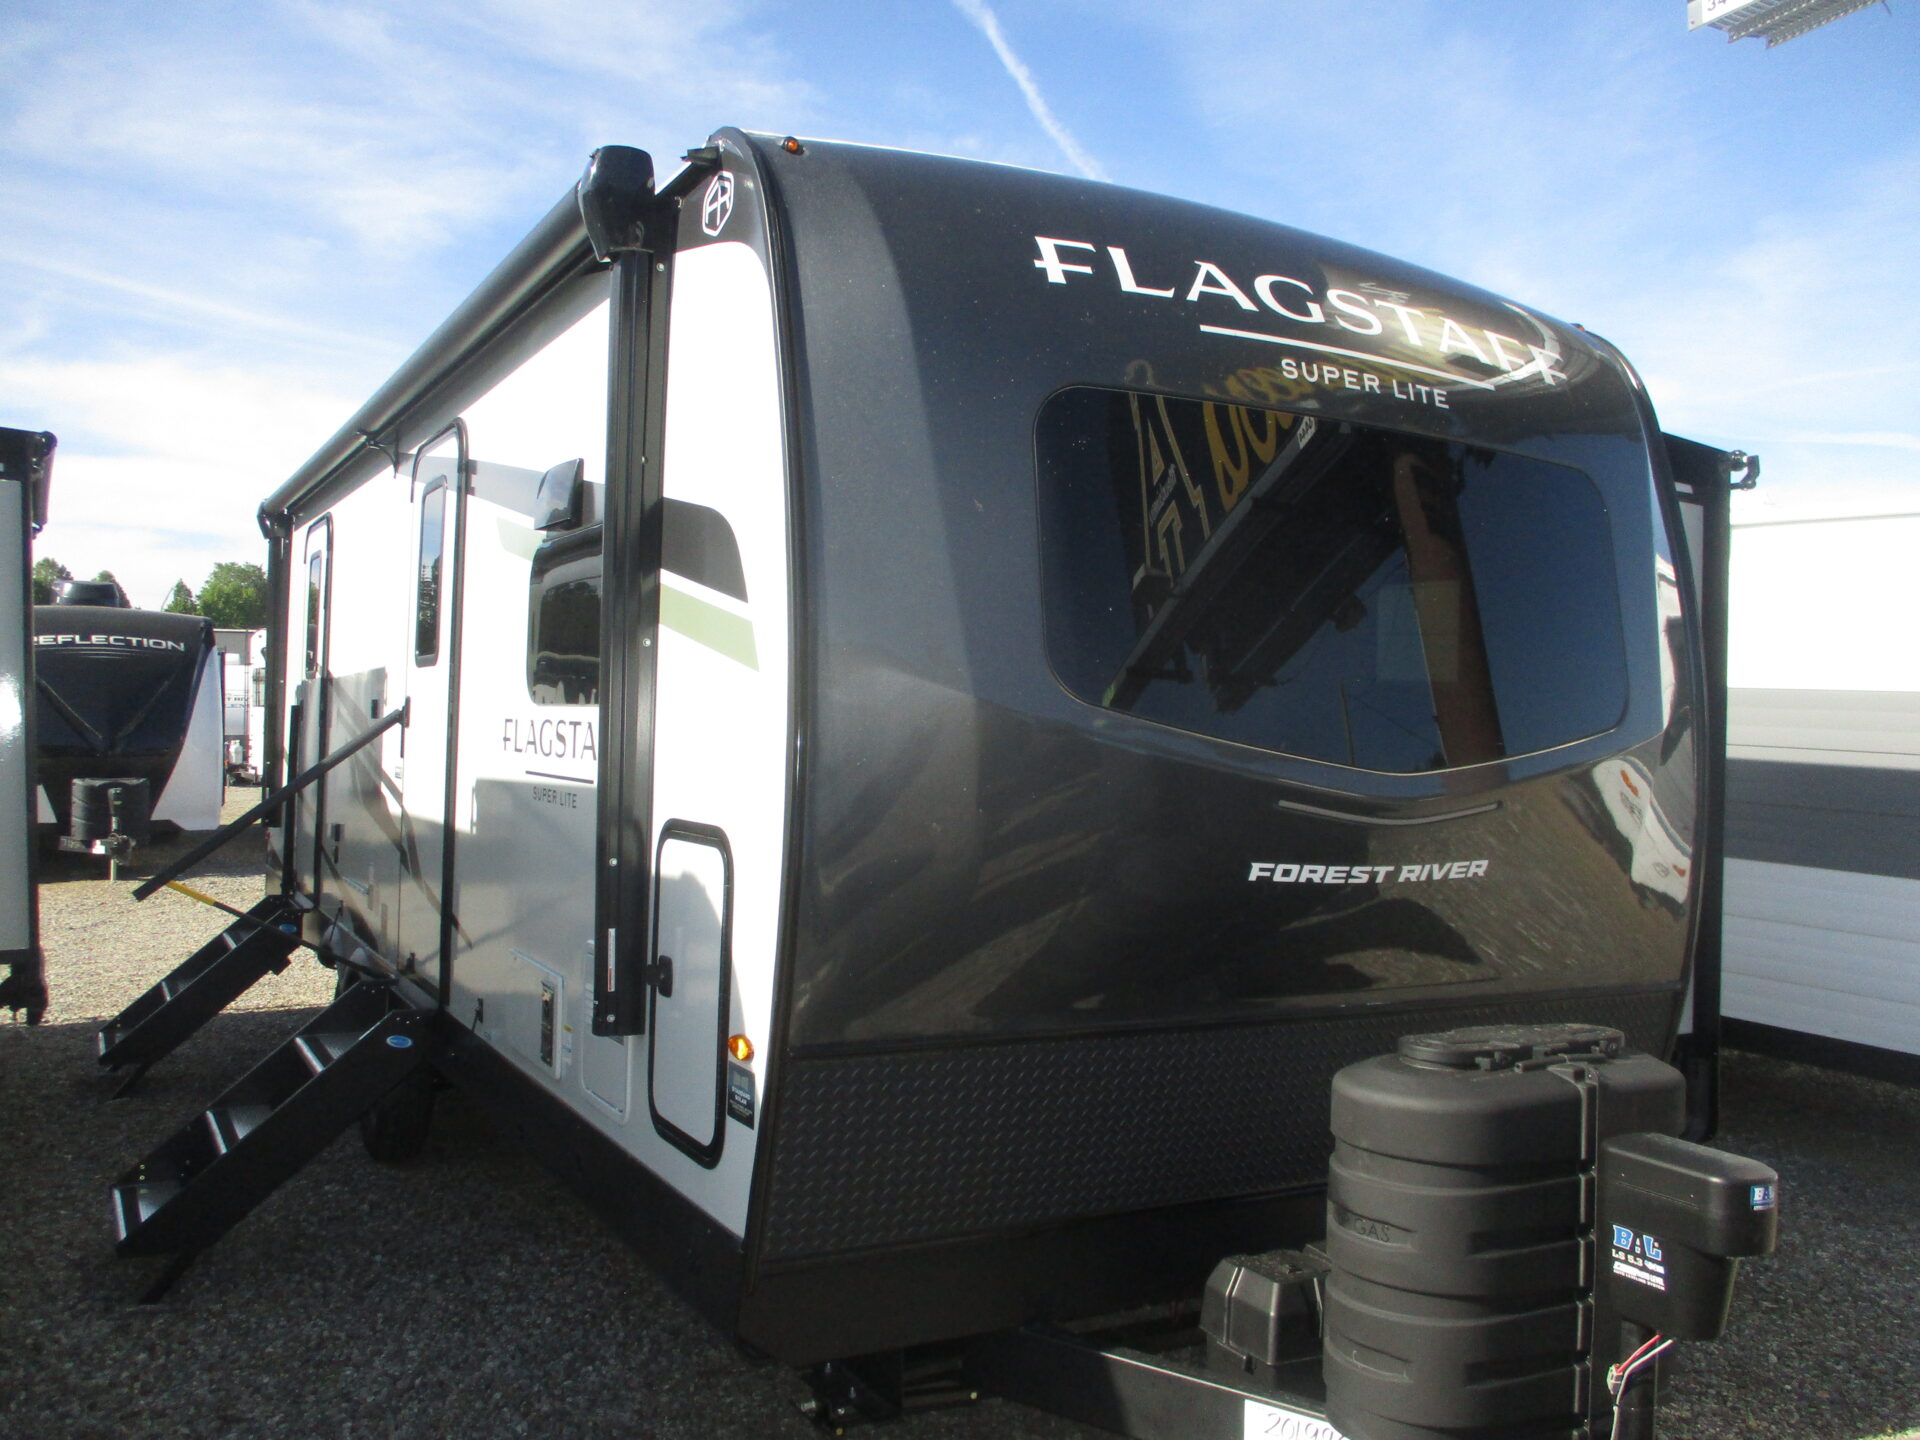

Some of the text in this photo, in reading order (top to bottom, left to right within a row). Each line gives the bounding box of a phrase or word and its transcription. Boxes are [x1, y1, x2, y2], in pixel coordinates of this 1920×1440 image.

[1034, 235, 1568, 386] FLAGSTAFF
[1281, 358, 1450, 409] SUPER LITE
[503, 718, 597, 761] FLAGSTA
[532, 785, 577, 809] SUPER LITE
[1248, 859, 1489, 884] FOREST RIVER
